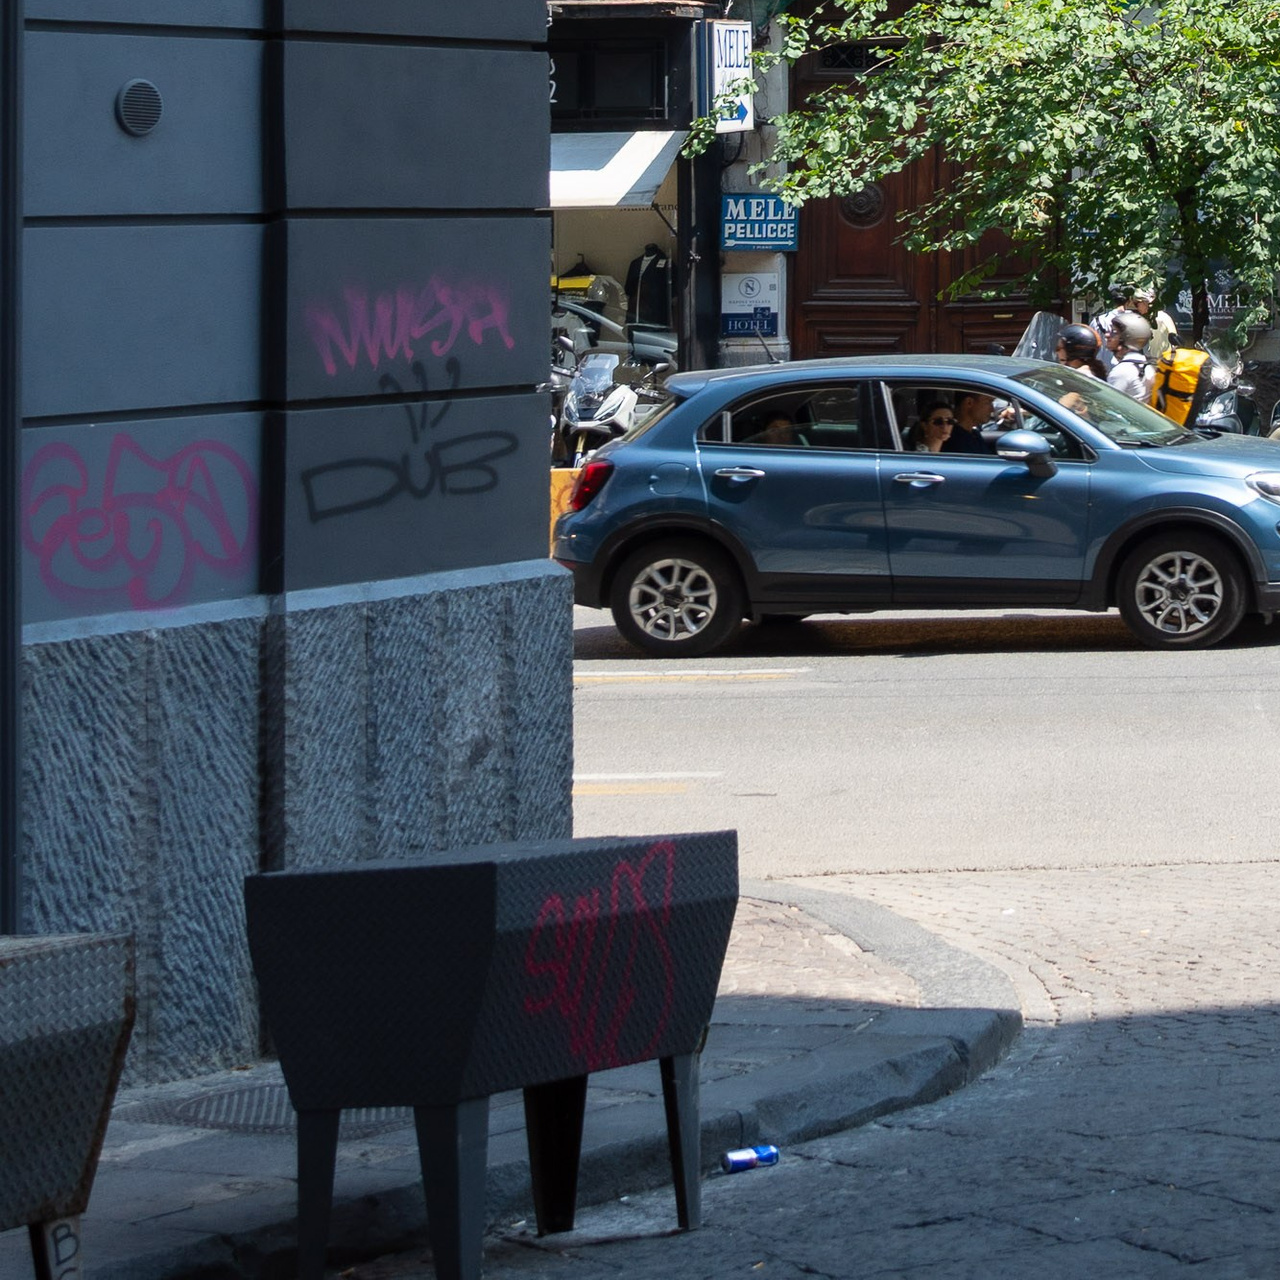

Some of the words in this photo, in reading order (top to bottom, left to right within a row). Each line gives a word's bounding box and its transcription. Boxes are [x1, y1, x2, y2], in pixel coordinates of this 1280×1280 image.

[717, 28, 750, 69] MELE
[724, 199, 796, 220] MELE
[724, 223, 795, 238] PELLICCE
[1207, 294, 1248, 309] MEL
